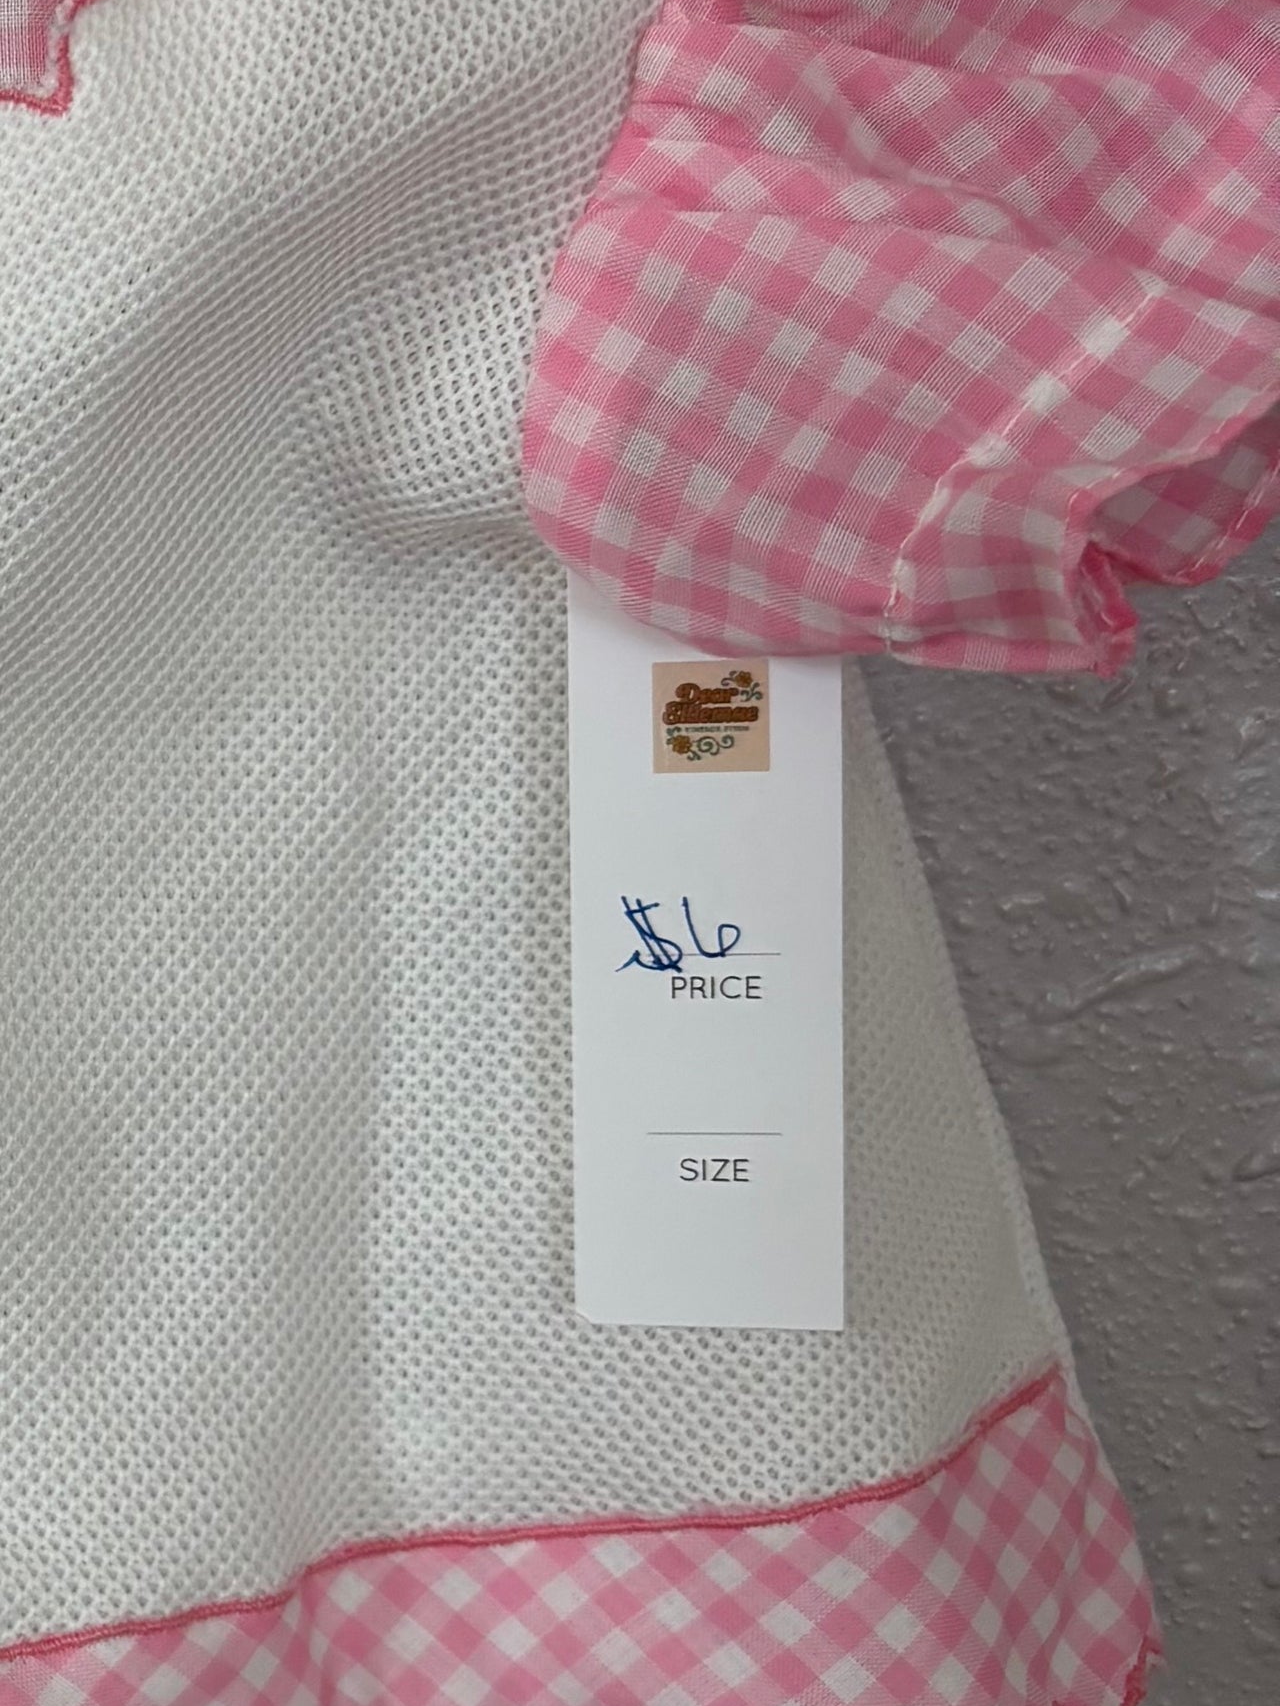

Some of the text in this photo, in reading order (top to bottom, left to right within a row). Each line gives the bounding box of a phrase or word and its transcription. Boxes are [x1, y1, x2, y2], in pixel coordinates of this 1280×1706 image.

[615, 895, 741, 974] $6
[671, 975, 763, 999] PRICE
[679, 1157, 750, 1182] SIZE
